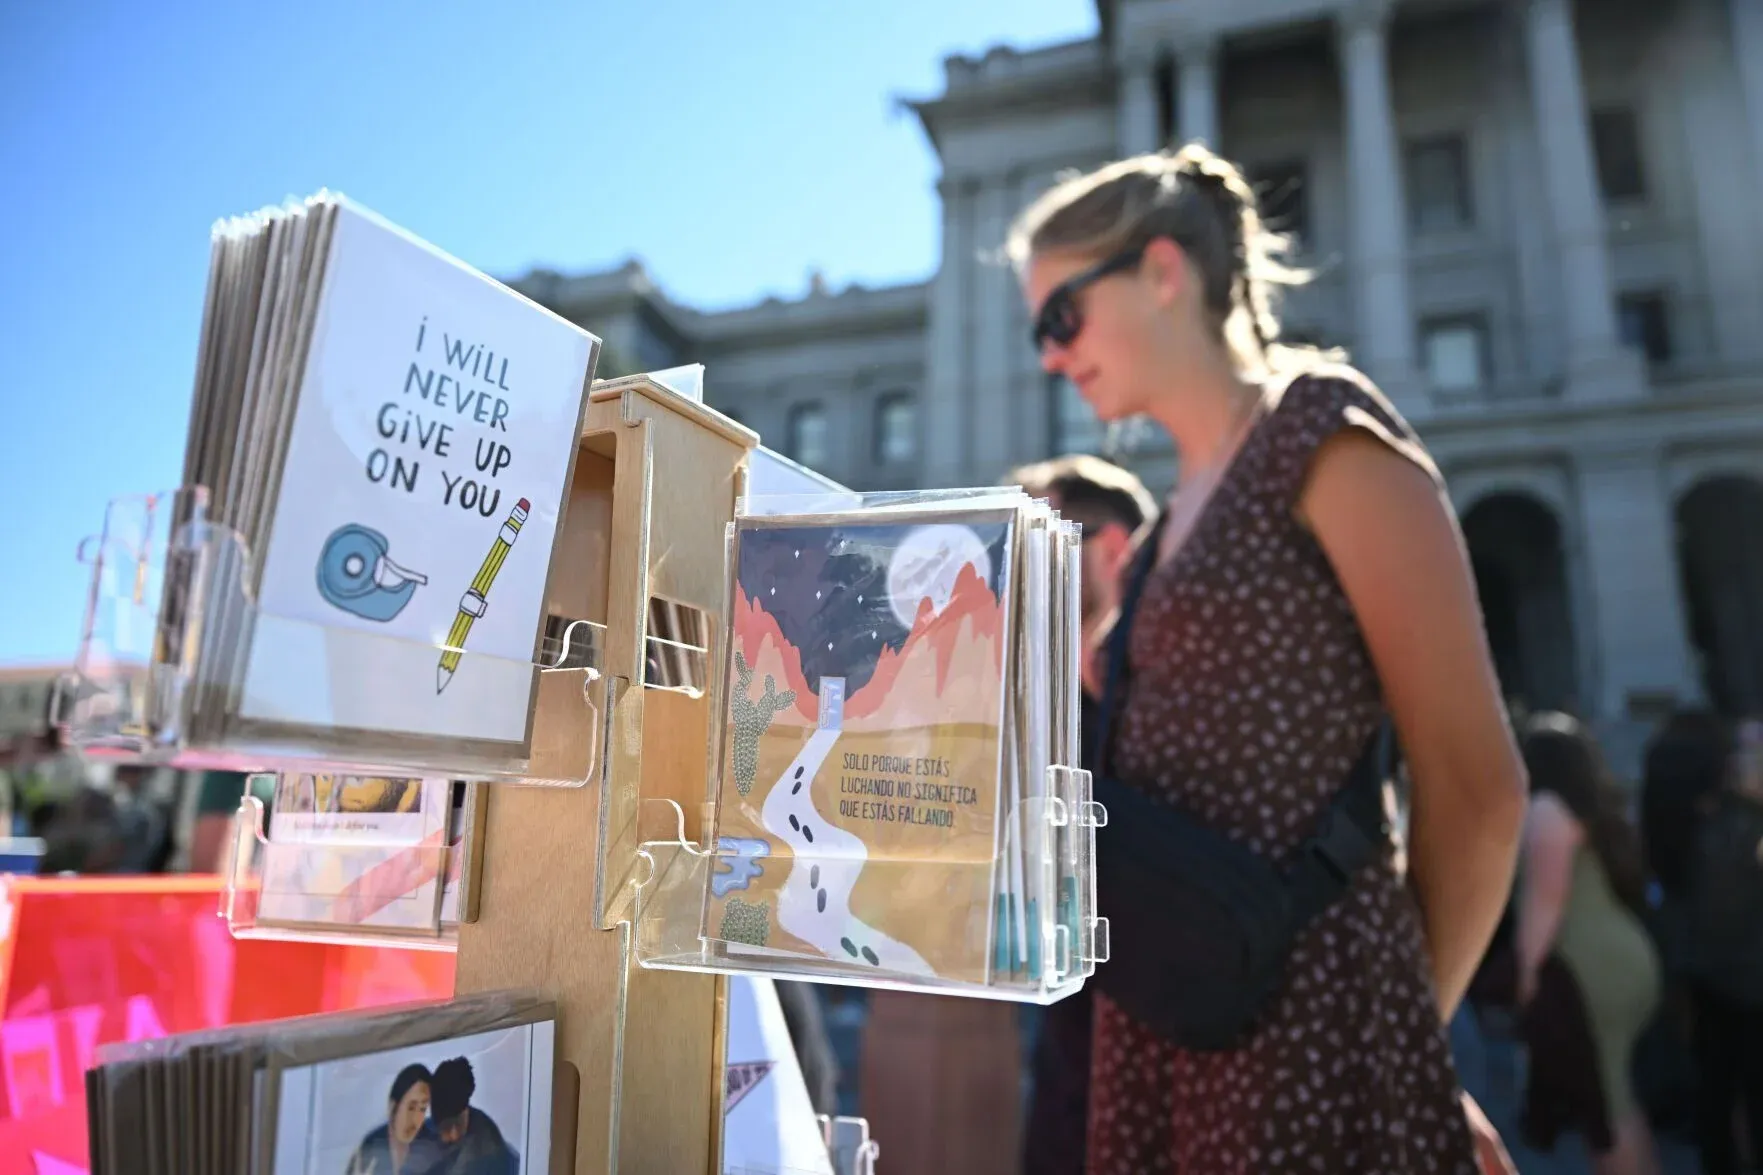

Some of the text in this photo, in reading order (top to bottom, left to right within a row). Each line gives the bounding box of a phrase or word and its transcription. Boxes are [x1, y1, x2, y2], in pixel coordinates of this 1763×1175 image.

[404, 362, 509, 432] NEVER
[475, 438, 511, 478] UP
[366, 448, 501, 517] ON YOU
[843, 753, 949, 777] SOLO PORQUE ESTÁS
[841, 776, 977, 805] LUCHANDO NO SIGNIFICA
[840, 799, 858, 818] QUE
[862, 801, 894, 822] ESTÁS
